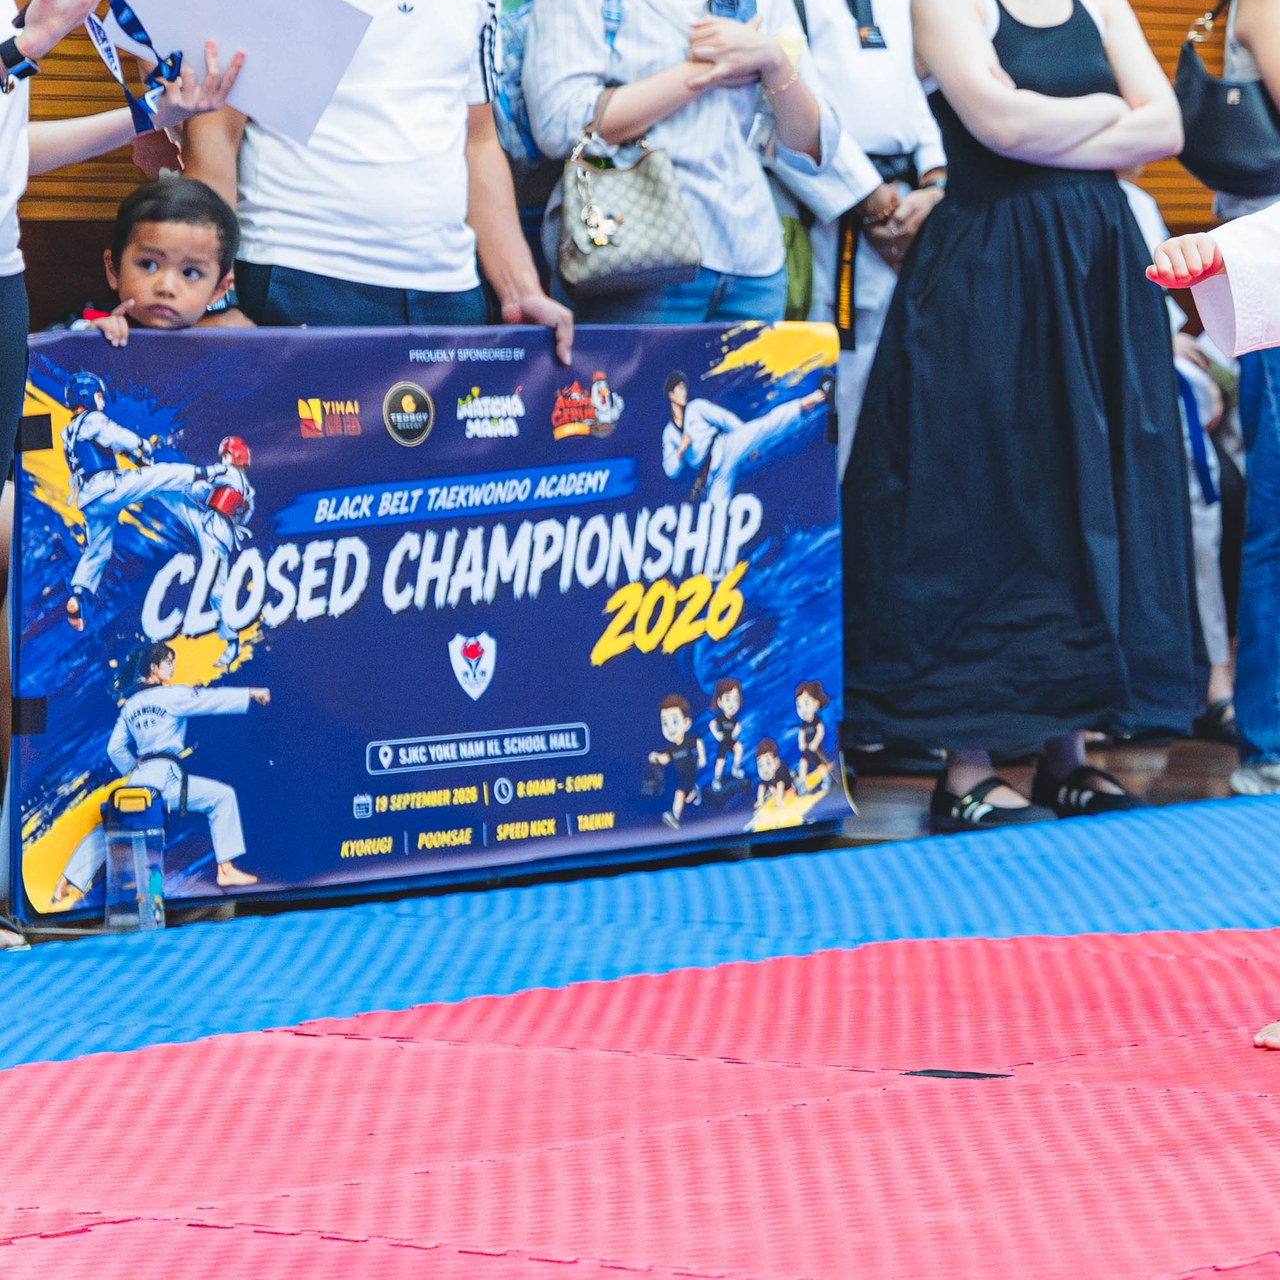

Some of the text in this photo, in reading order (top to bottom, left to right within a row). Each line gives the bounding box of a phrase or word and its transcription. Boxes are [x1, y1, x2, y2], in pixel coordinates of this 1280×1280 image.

[409, 348, 525, 362] PROUDLY SPONSORED BY
[322, 399, 360, 415] YIHAI
[457, 394, 526, 420] MATCHA
[314, 469, 610, 523] BLACK BELT TAEKWONDO ACADEMY
[140, 493, 765, 644] CLOSED CHAMPIONSHIP
[590, 561, 750, 667] 2026
[398, 745, 427, 765] SJKC
[429, 742, 458, 763] YOKE
[459, 740, 484, 760] NAM
[503, 733, 547, 755] SCHOOL
[548, 731, 580, 751] HALL
[565, 773, 604, 793] 5:00PM
[389, 788, 452, 812] SEPTEMBER
[417, 828, 473, 851] POOMSAE
[496, 818, 556, 841] SPEED KICK
[340, 836, 393, 859] KYORUGI
